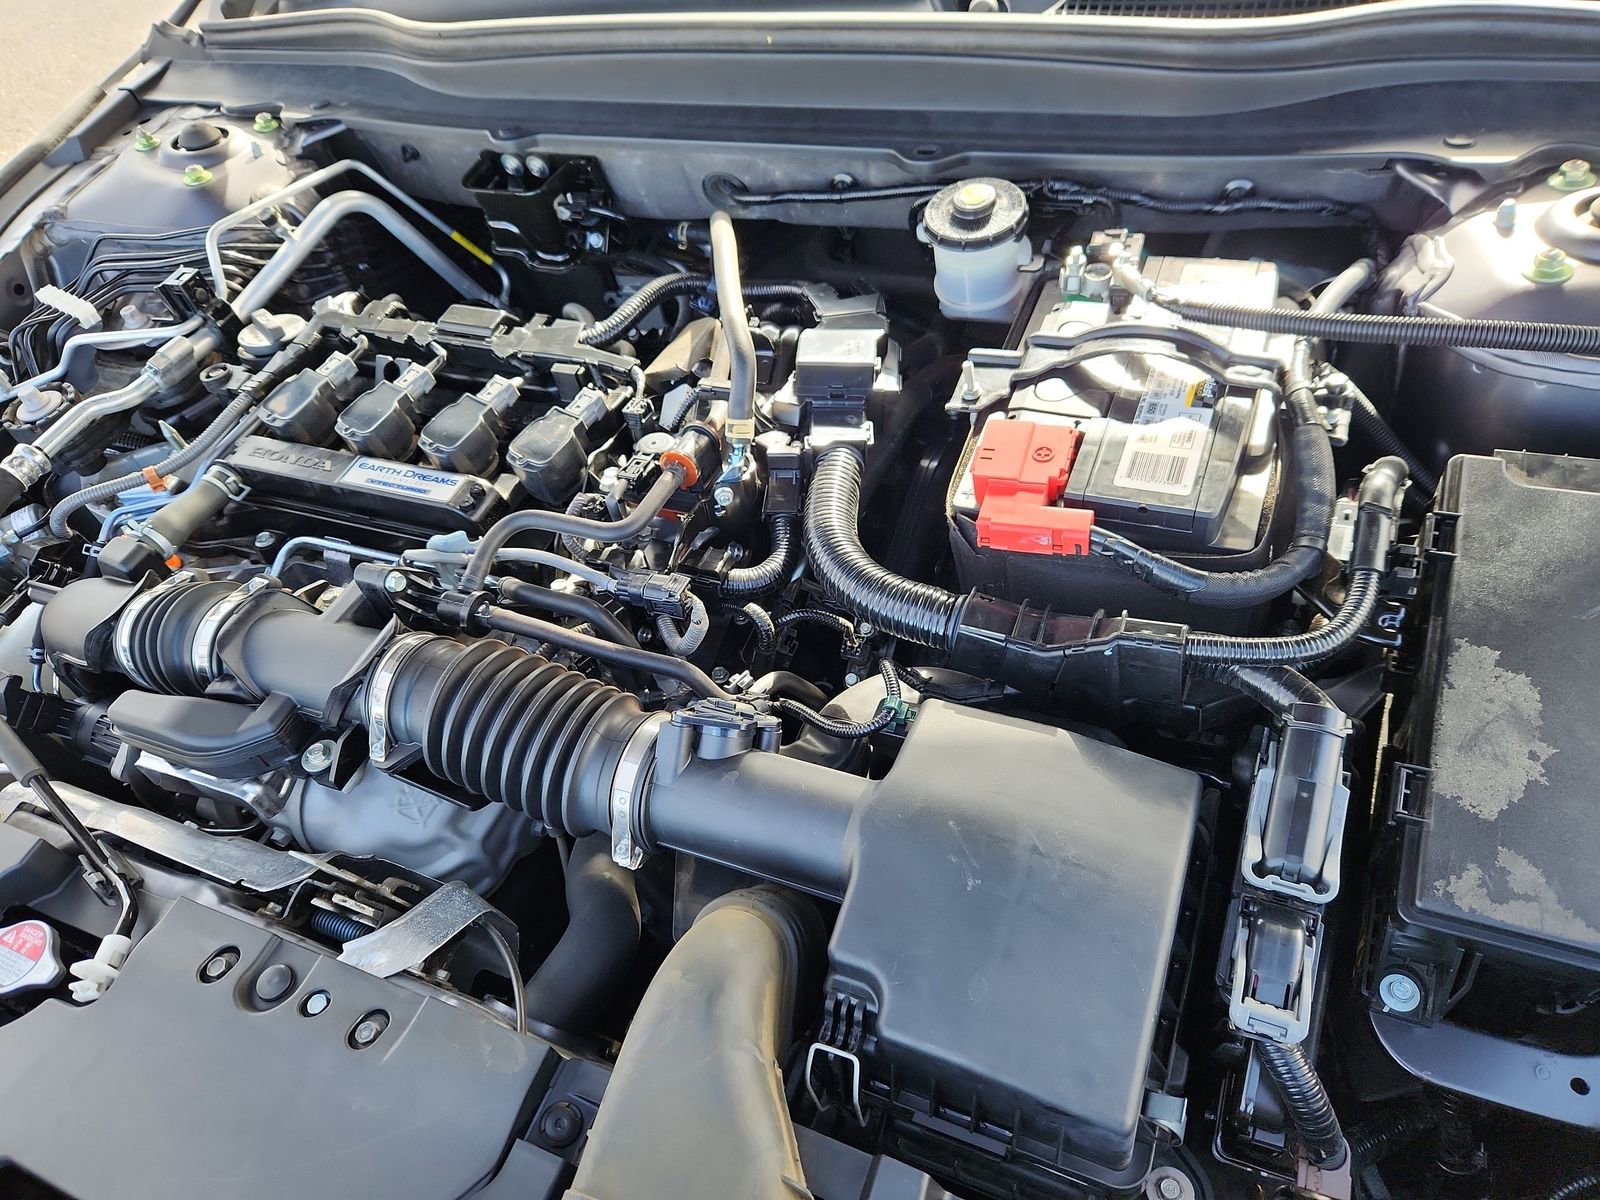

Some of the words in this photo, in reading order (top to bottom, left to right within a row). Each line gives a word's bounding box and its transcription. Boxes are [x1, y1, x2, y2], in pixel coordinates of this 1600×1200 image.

[248, 446, 333, 472] HONDA
[358, 462, 402, 477] EARTH
[403, 469, 458, 487] DREAMS
